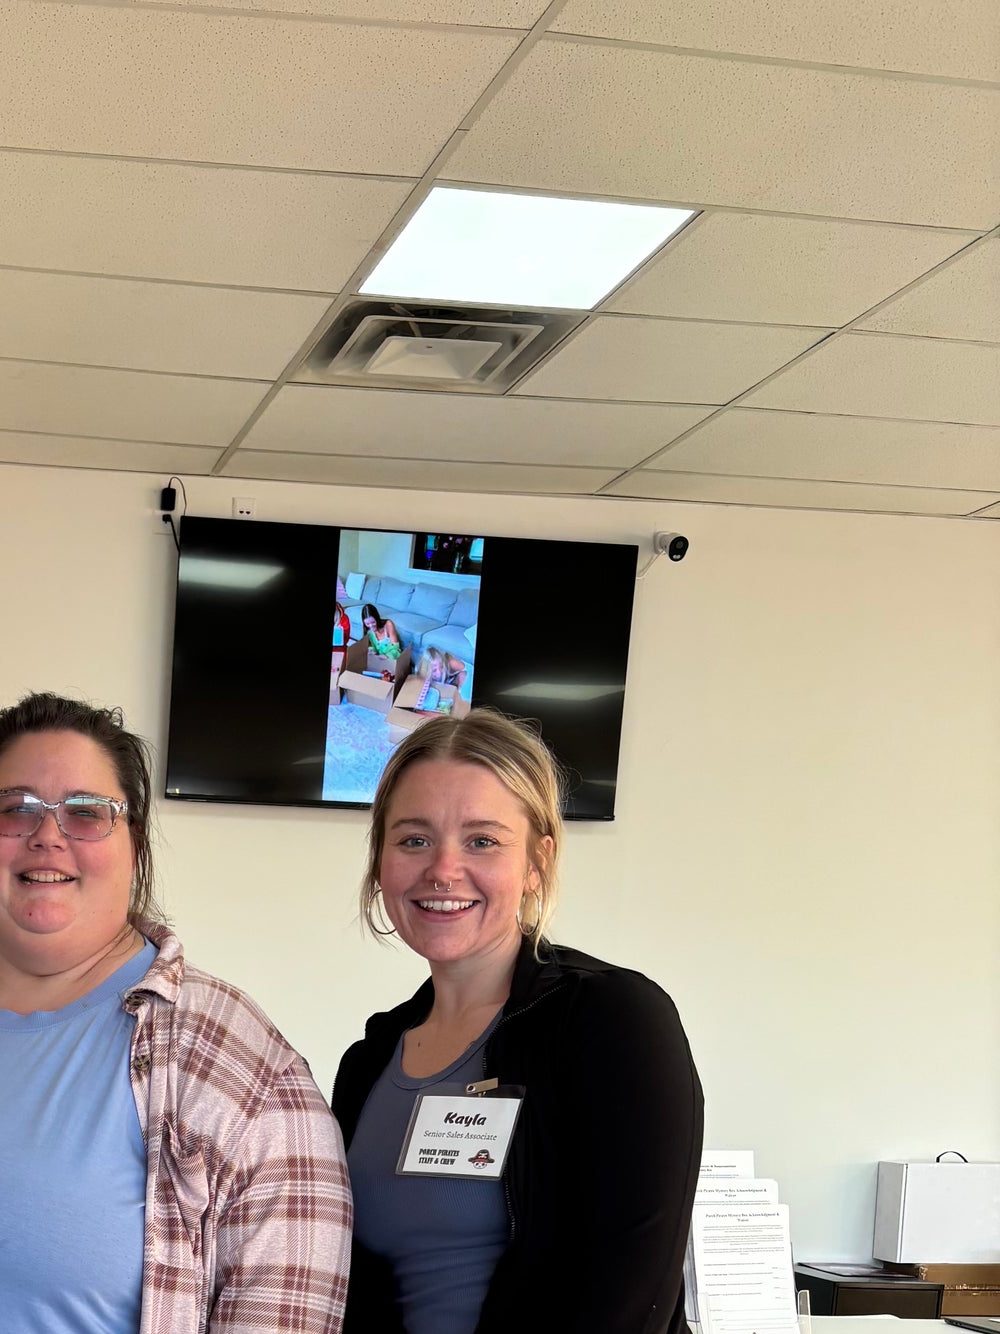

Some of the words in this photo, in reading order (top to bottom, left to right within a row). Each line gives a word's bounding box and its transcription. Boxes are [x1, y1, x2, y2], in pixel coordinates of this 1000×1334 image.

[443, 1111, 487, 1127] Kayla
[423, 1130, 446, 1138] Senior
[446, 1131, 464, 1139] Sales
[464, 1132, 498, 1141] Associate
[418, 1148, 437, 1156] PORCH
[437, 1149, 460, 1157] PIRATES
